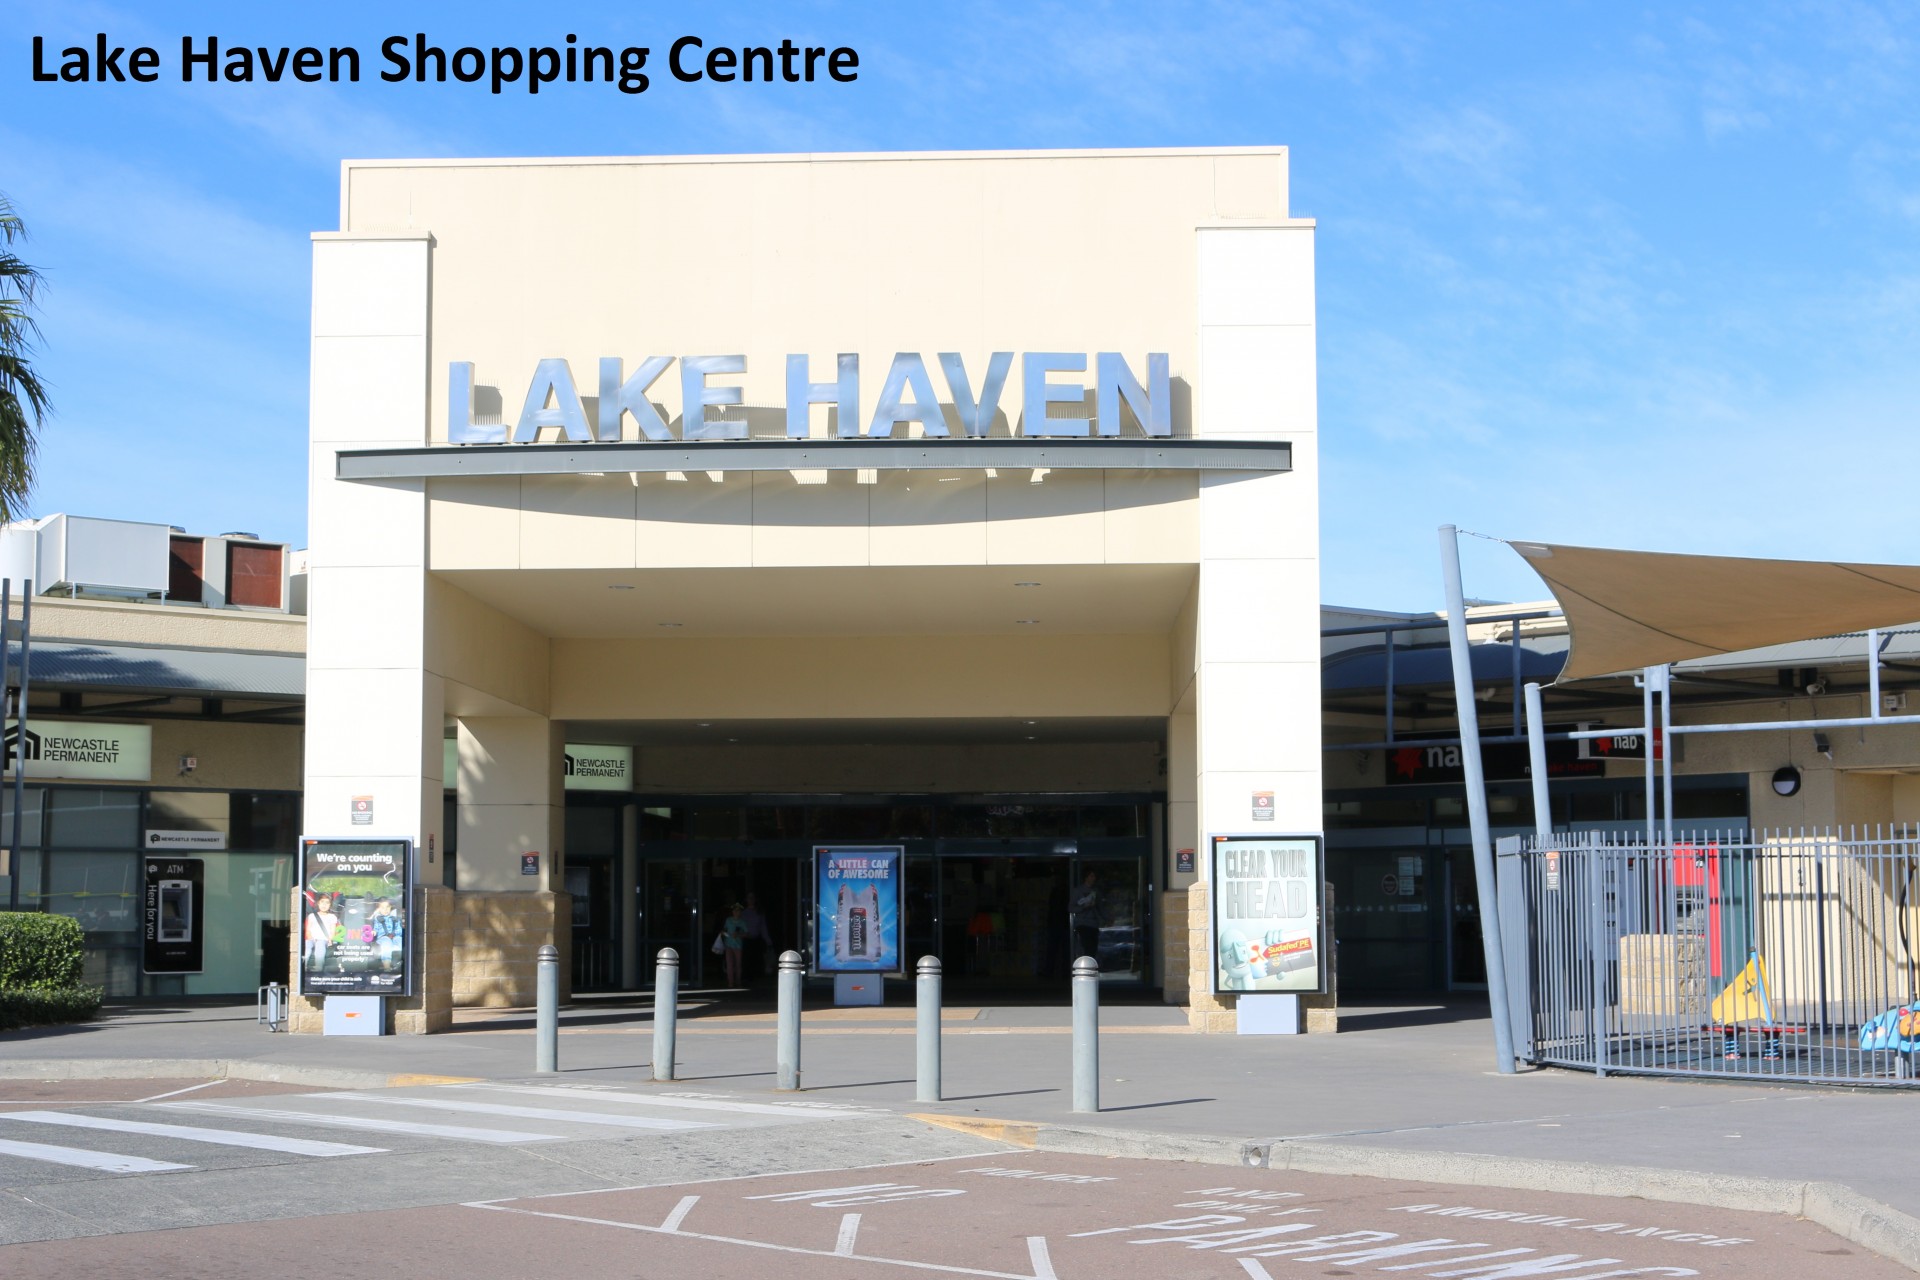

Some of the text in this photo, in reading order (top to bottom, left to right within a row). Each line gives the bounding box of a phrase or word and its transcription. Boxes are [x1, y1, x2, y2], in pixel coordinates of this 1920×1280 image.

[448, 352, 1171, 445] LAKE HAVEN
[44, 737, 119, 751] NEWCASTLE
[44, 750, 119, 763] PERMANENT
[576, 759, 625, 769] NEWCASTLE
[1426, 745, 1461, 768] na
[576, 768, 625, 777] PERMANENT
[316, 852, 393, 865] We're counting
[828, 859, 889, 869] A LITTLE CAN
[1225, 849, 1308, 879] CLEAR YOUR
[167, 864, 184, 874] ATM
[353, 864, 372, 873] you
[828, 869, 889, 879] OF AWESOME
[1225, 881, 1308, 919] HEAD
[146, 884, 157, 940] Here for you
[332, 925, 346, 943] 2
[361, 924, 374, 943] 3
[1267, 939, 1310, 954] Sudafed PE
[741, 1183, 968, 1207] NO
[957, 1167, 1755, 1247] POLICE AND AMBULANCE
[1173, 1200, 1324, 1216] ONLY
